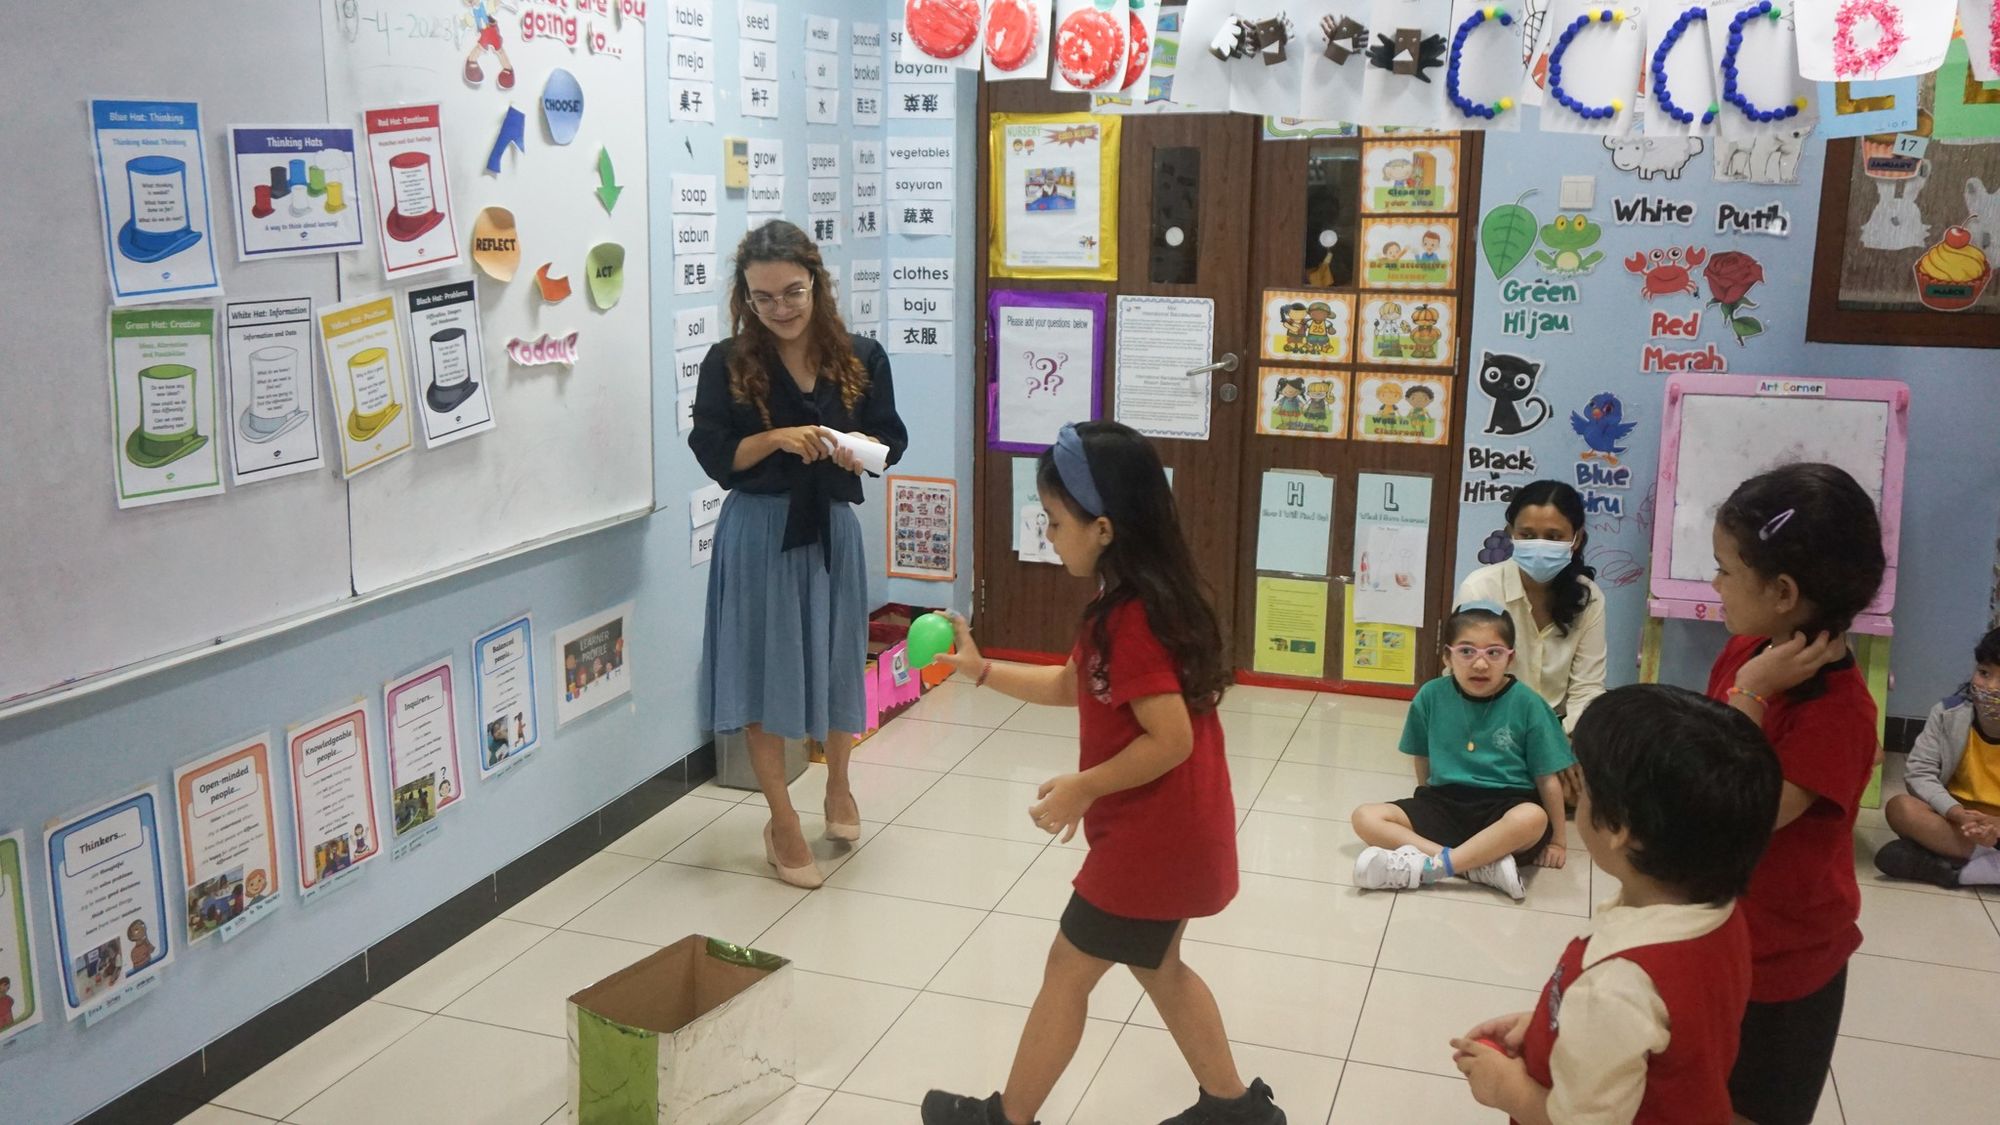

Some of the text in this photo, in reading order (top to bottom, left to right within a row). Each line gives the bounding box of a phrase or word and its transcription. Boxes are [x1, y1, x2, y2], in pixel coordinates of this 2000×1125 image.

[676, 8, 704, 27] table
[746, 14, 770, 30] seed
[523, 10, 577, 45] going
[853, 33, 880, 47] broccoli
[677, 51, 704, 72] meja
[754, 51, 767, 72] biji
[895, 61, 948, 77] bayam
[854, 66, 880, 82] brokoli
[544, 99, 579, 112] CHOOSE
[680, 90, 703, 113] 桌子
[150, 113, 184, 125] Thinking
[1008, 126, 1040, 137] NURSERY
[266, 137, 323, 149] Thinking Hats
[1900, 138, 1918, 152] 17
[754, 152, 777, 168] grow
[890, 147, 950, 160] vegetables
[812, 156, 835, 170] grapes
[1870, 160, 1912, 169] JANUARY
[858, 184, 876, 197] buah
[896, 179, 942, 193] sayuran
[681, 188, 707, 206] soap
[752, 189, 780, 200] tumbuh
[812, 191, 837, 205] anggur
[857, 211, 876, 232] 水果
[904, 208, 934, 224] 蔬菜
[1614, 199, 1788, 231] White Putih
[679, 227, 709, 243] sabun
[476, 238, 516, 251] REFLECT
[596, 265, 613, 278] ACT
[684, 264, 706, 286] 肥皂
[853, 269, 880, 283] cabbage
[893, 266, 949, 280] clothes
[416, 297, 431, 306] Black
[444, 289, 468, 300] Problems
[1503, 279, 1577, 303] Green
[232, 306, 307, 320] White Hat: Information
[860, 299, 872, 315] kol
[904, 298, 937, 314] baju
[125, 321, 149, 330] Green
[688, 317, 705, 336] soil
[1007, 315, 1088, 331] Please add your questions below
[1312, 325, 1324, 333] 25
[1503, 311, 1571, 338] Hijau
[1652, 312, 1699, 337] Red
[904, 327, 938, 345] 衣服
[1643, 344, 1725, 372] Merah
[1760, 382, 1823, 392] Art Corner
[1469, 447, 1535, 470] Black
[1576, 463, 1629, 487] Blue
[1287, 481, 1304, 507] H
[1384, 481, 1399, 511] L
[580, 631, 609, 651] LEARNER
[305, 730, 352, 756] Knowledgeable
[199, 765, 249, 793] Open-minded
[79, 830, 127, 855] Thinkers...
